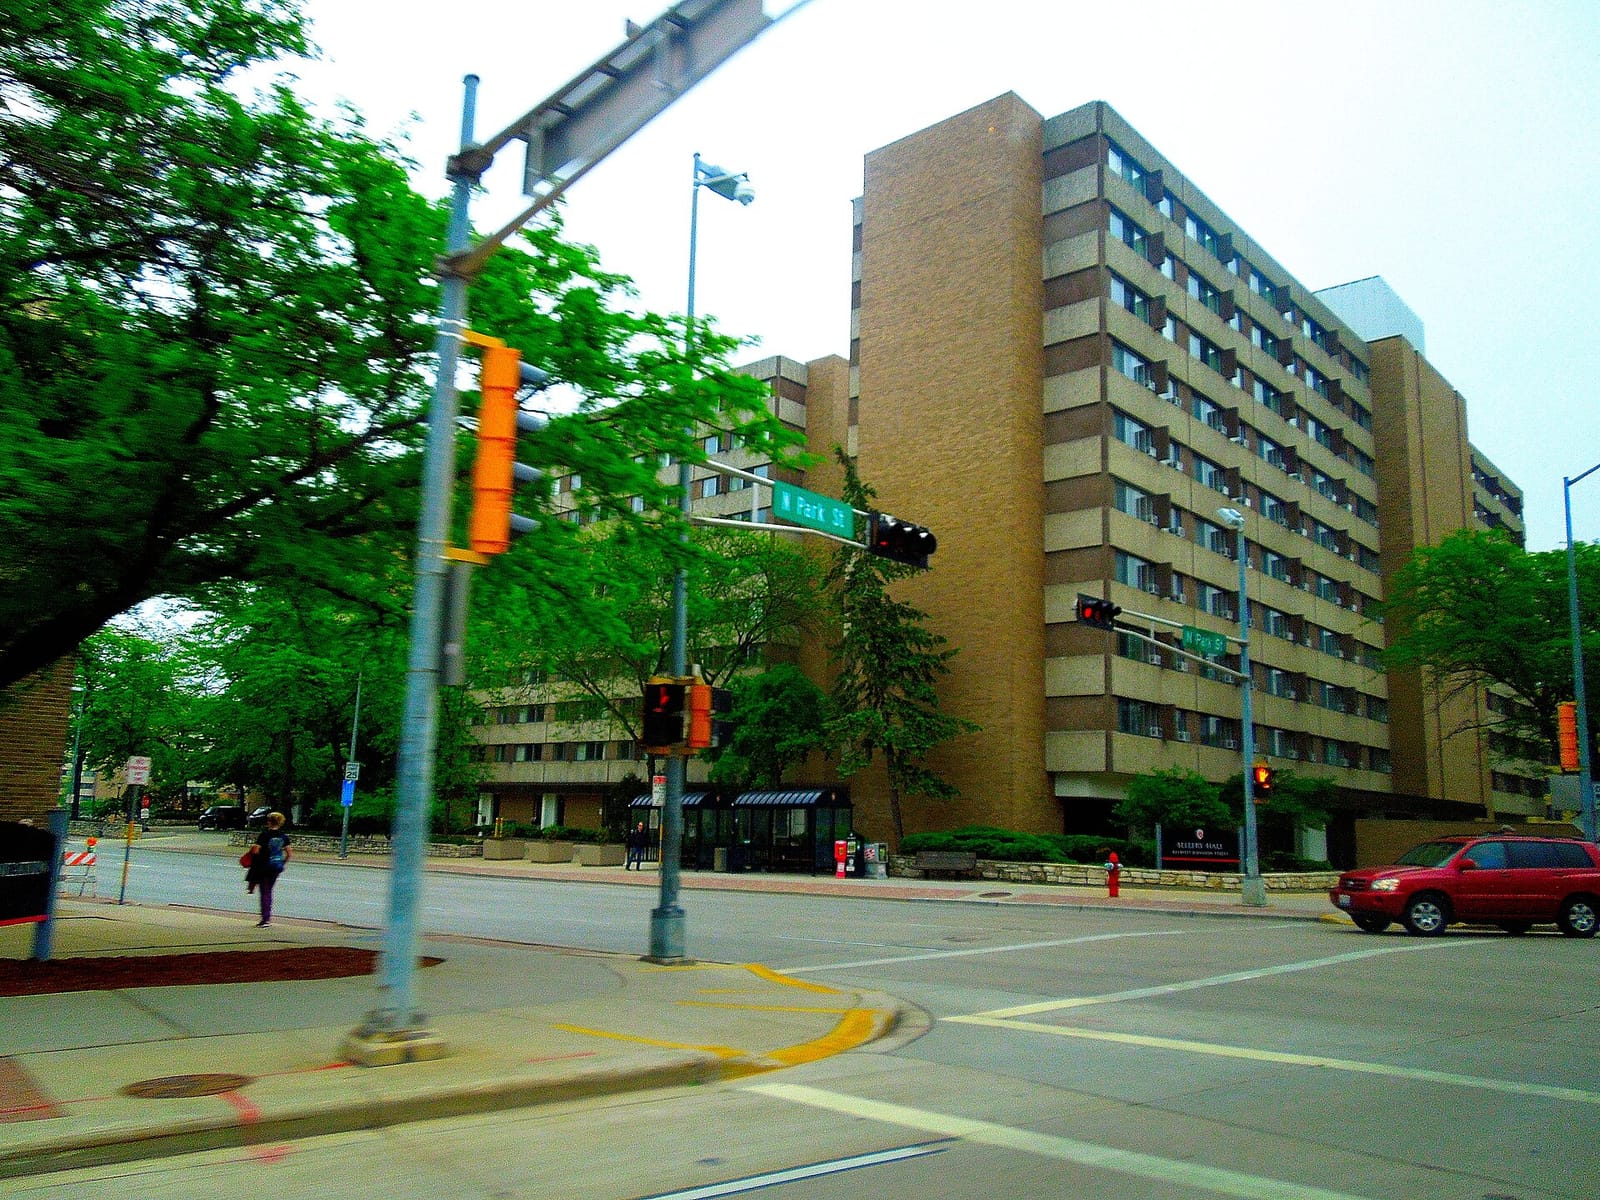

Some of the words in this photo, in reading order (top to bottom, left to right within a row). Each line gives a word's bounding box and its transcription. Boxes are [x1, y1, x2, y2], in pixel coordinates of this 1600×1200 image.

[796, 495, 826, 522] Park
[831, 507, 845, 528] St
[346, 771, 357, 779] 25
